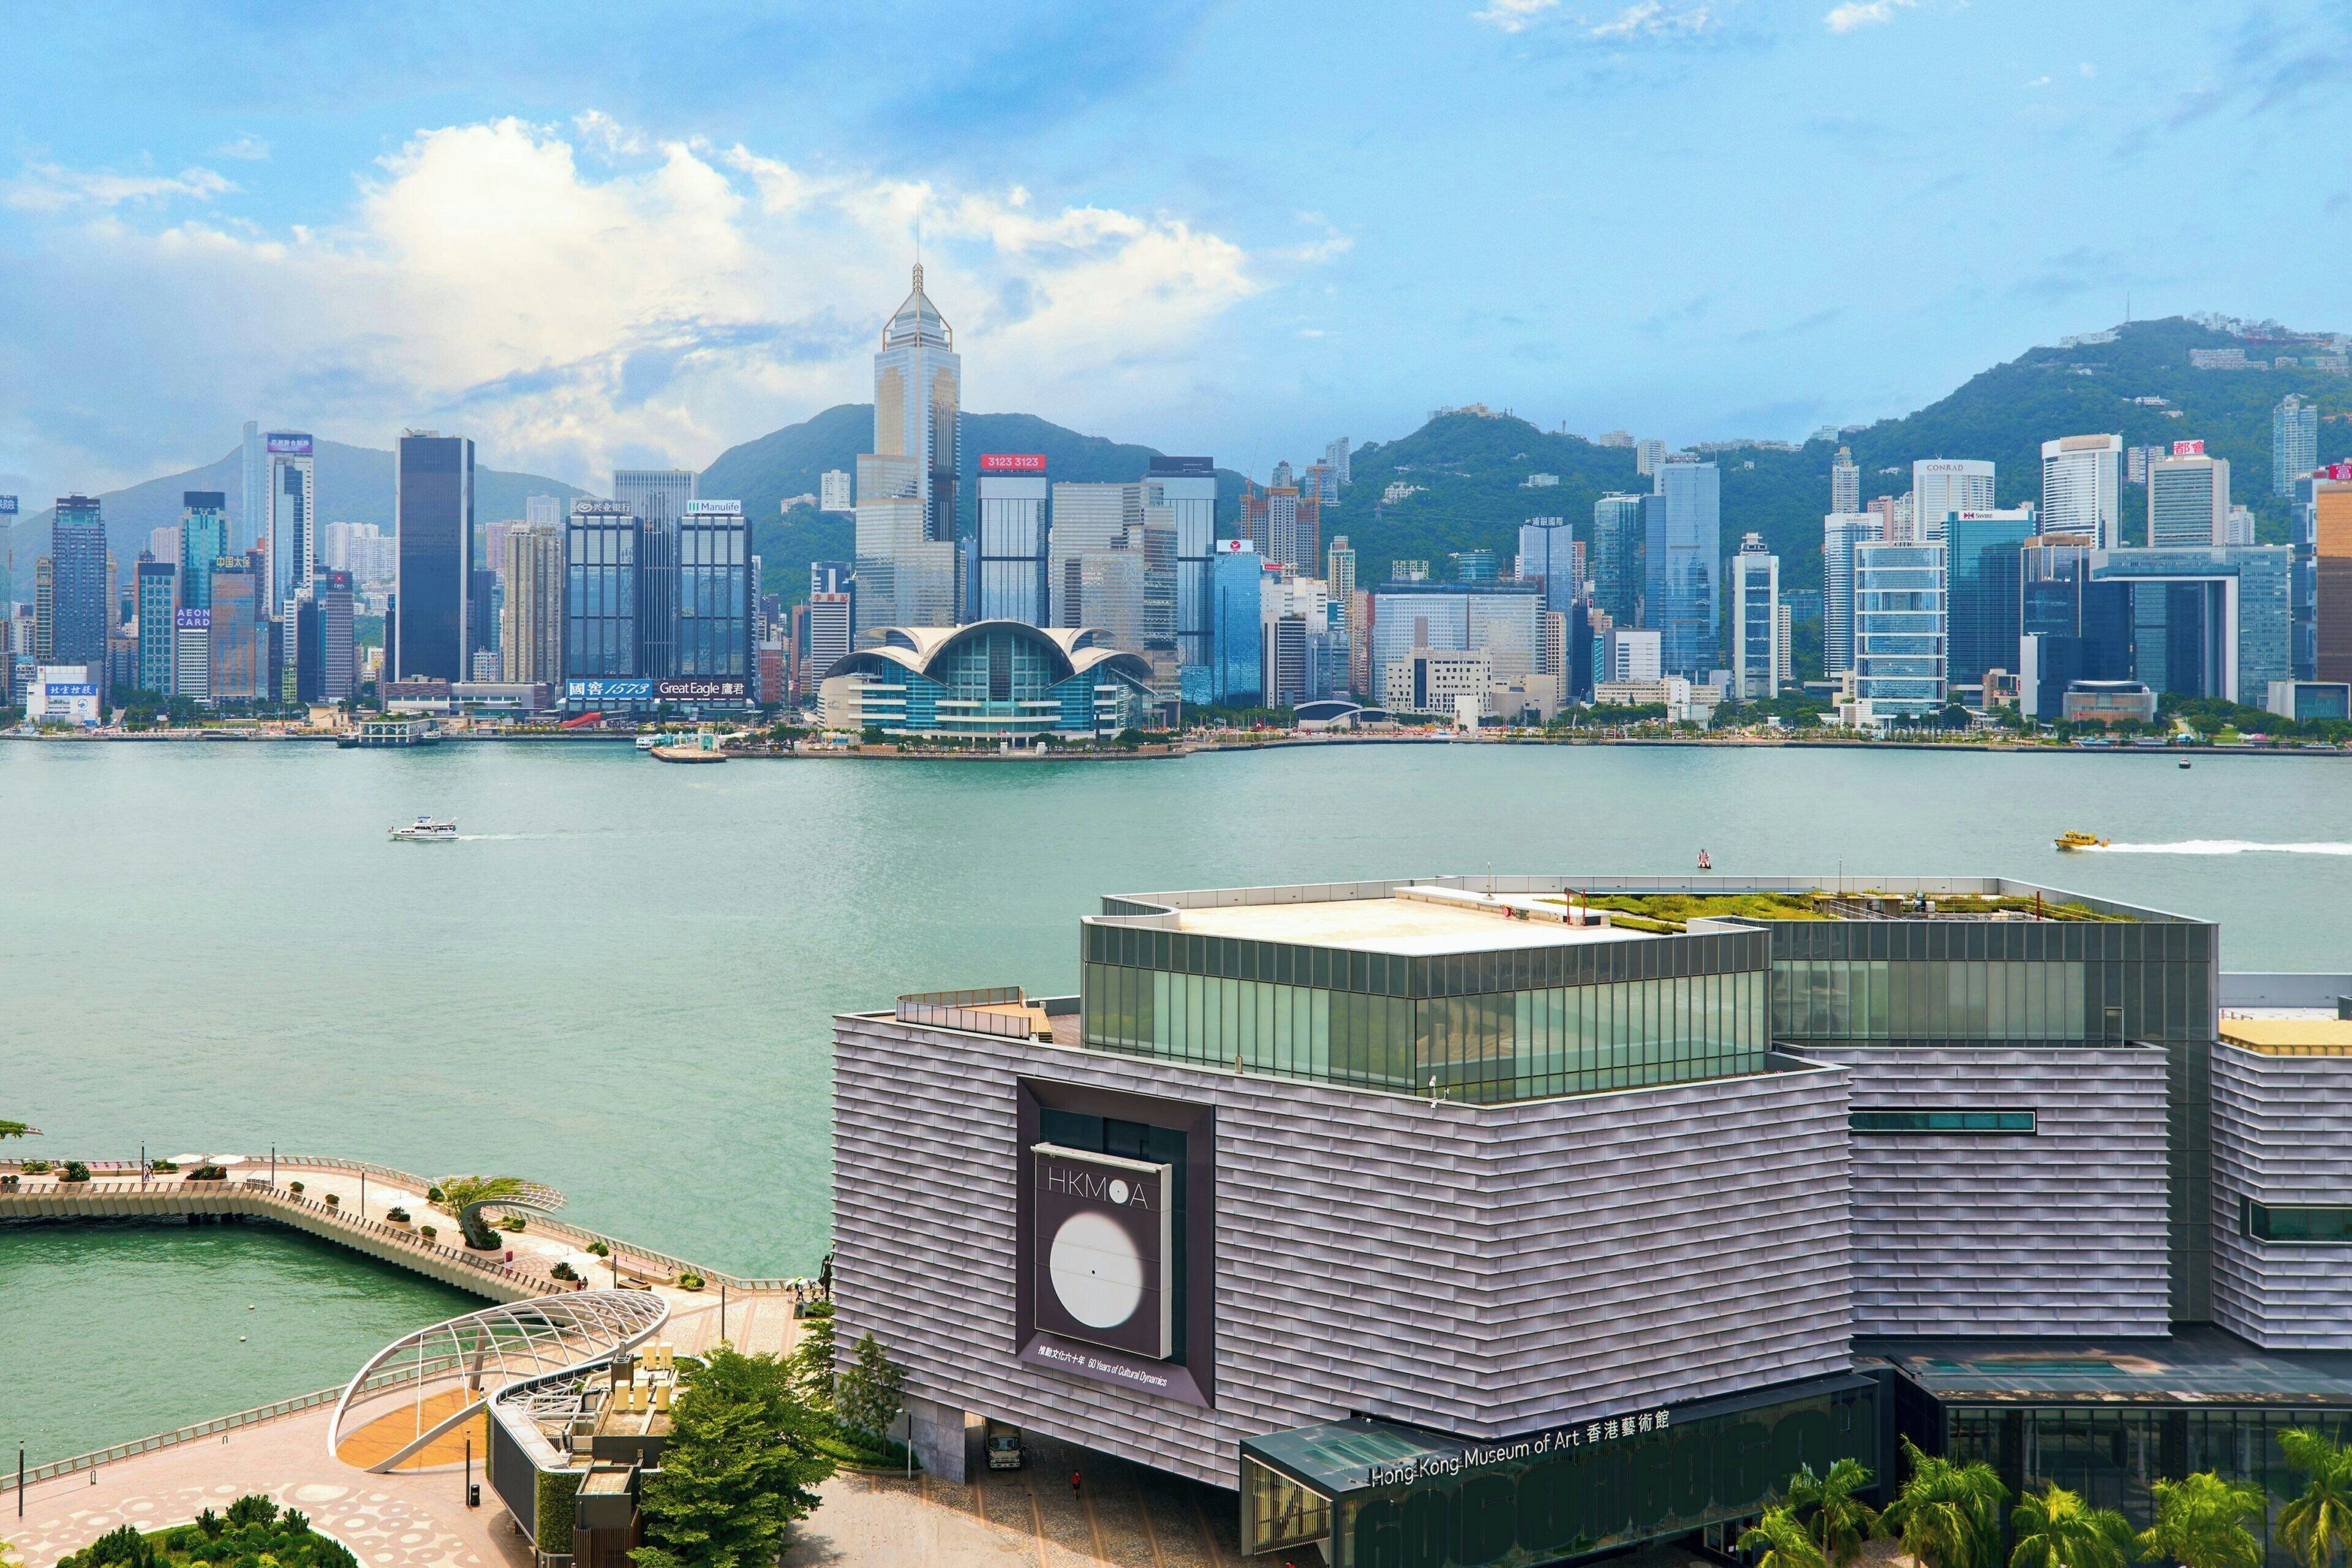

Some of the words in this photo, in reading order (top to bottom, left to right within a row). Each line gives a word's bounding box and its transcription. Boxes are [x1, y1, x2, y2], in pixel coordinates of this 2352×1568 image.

[988, 457, 1012, 466] 3123
[1015, 457, 1038, 466] 3123
[592, 502, 631, 513] 兴业银行
[701, 502, 739, 511] Manulife
[1532, 516, 1564, 526] 浦銀國際
[216, 556, 251, 568] 中国太保
[177, 608, 210, 617] AEON
[660, 682, 690, 695] Great
[691, 682, 720, 696] Eagle
[721, 682, 745, 695] 鷹君
[1038, 1345, 1086, 1366] 推動文化六十年
[1088, 1358, 1096, 1368] 60
[1096, 1360, 1110, 1373] Years
[1111, 1365, 1118, 1374] of
[1118, 1366, 1140, 1380] Cultural
[1139, 1371, 1167, 1387] Dynamics
[1371, 1466, 1414, 1487] Hong
[1419, 1455, 1460, 1479] Kong
[1464, 1442, 1530, 1469] Museum
[1534, 1433, 1551, 1454] of
[1554, 1428, 1580, 1452] Art
[1586, 1409, 1670, 1444] 香港藝術館
